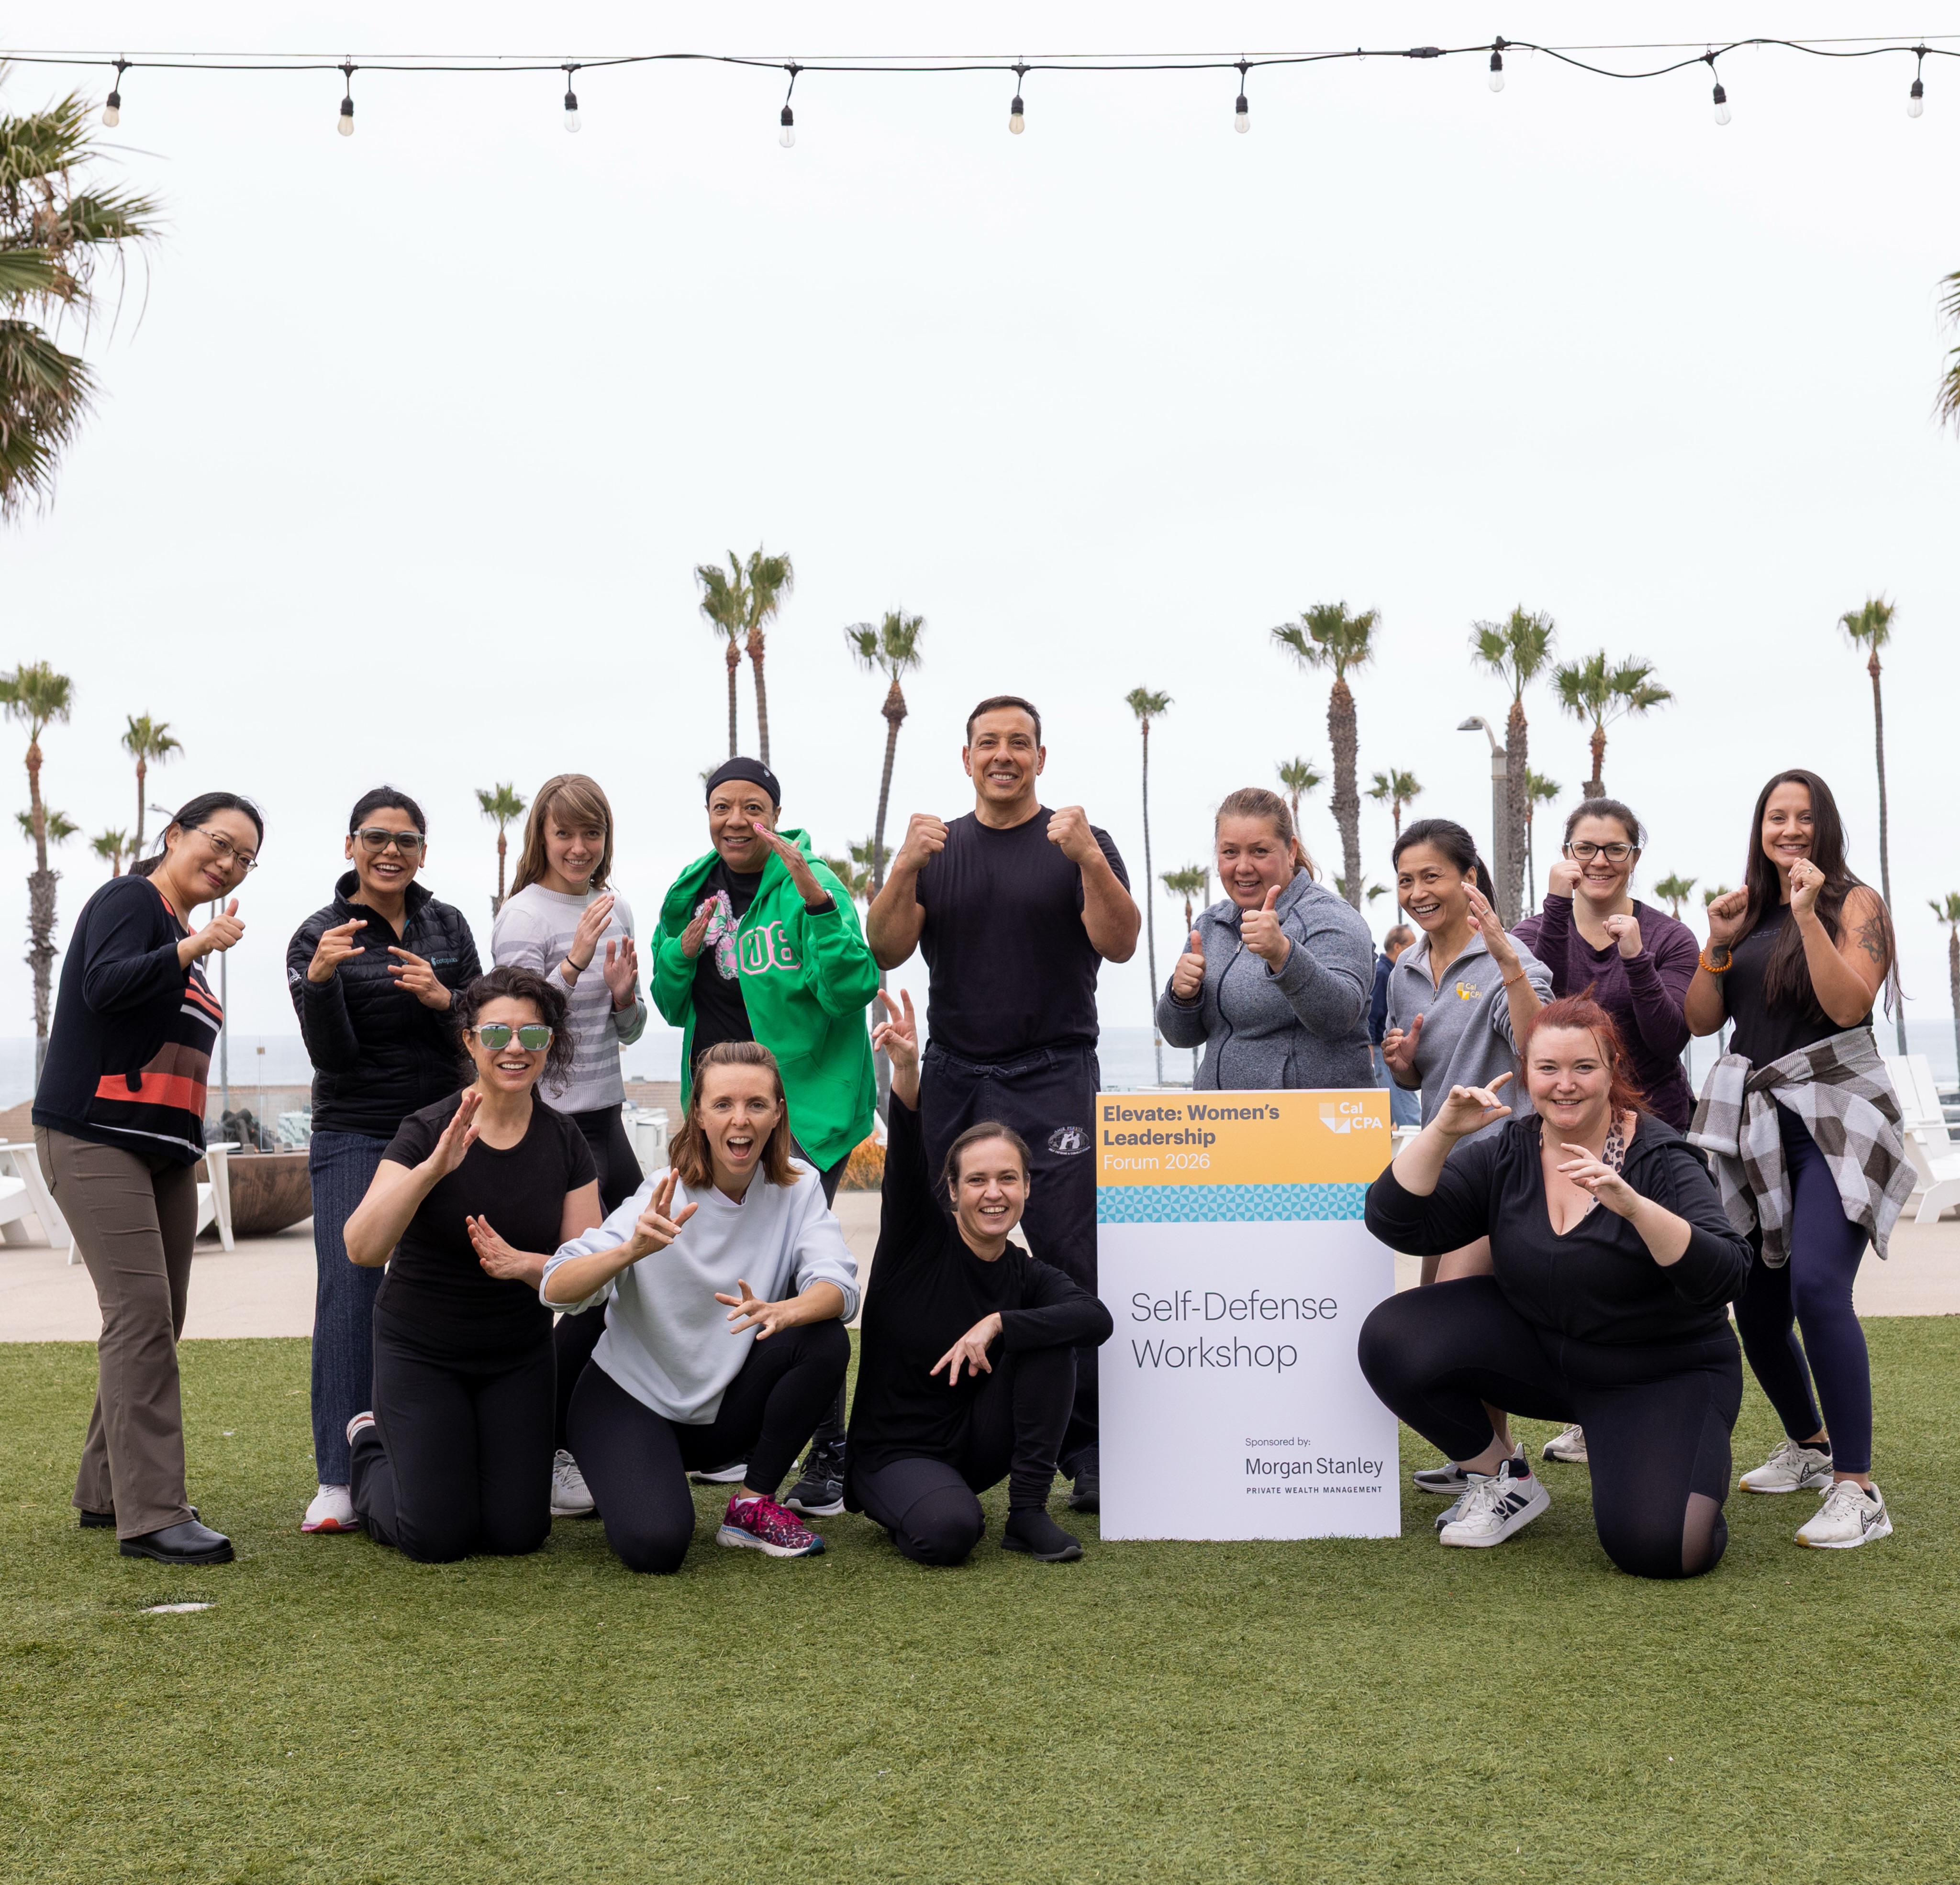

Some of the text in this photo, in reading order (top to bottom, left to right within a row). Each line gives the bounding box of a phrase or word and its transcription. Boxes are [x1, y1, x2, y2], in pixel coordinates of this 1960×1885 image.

[739, 920, 801, 975] 08
[1465, 982, 1476, 990] Cal
[1104, 1104, 1280, 1122] Elevate: Women’s
[1339, 1102, 1363, 1114] Cal
[1352, 1117, 1383, 1130] CPA
[1104, 1128, 1216, 1148] Leadership
[1104, 1153, 1211, 1170] Forum 2026
[1131, 1289, 1338, 1322] Self-Defense
[1132, 1336, 1298, 1374] Workshop
[1245, 1437, 1311, 1448] Sponsored by:
[1246, 1457, 1384, 1479] Morgan Stanley
